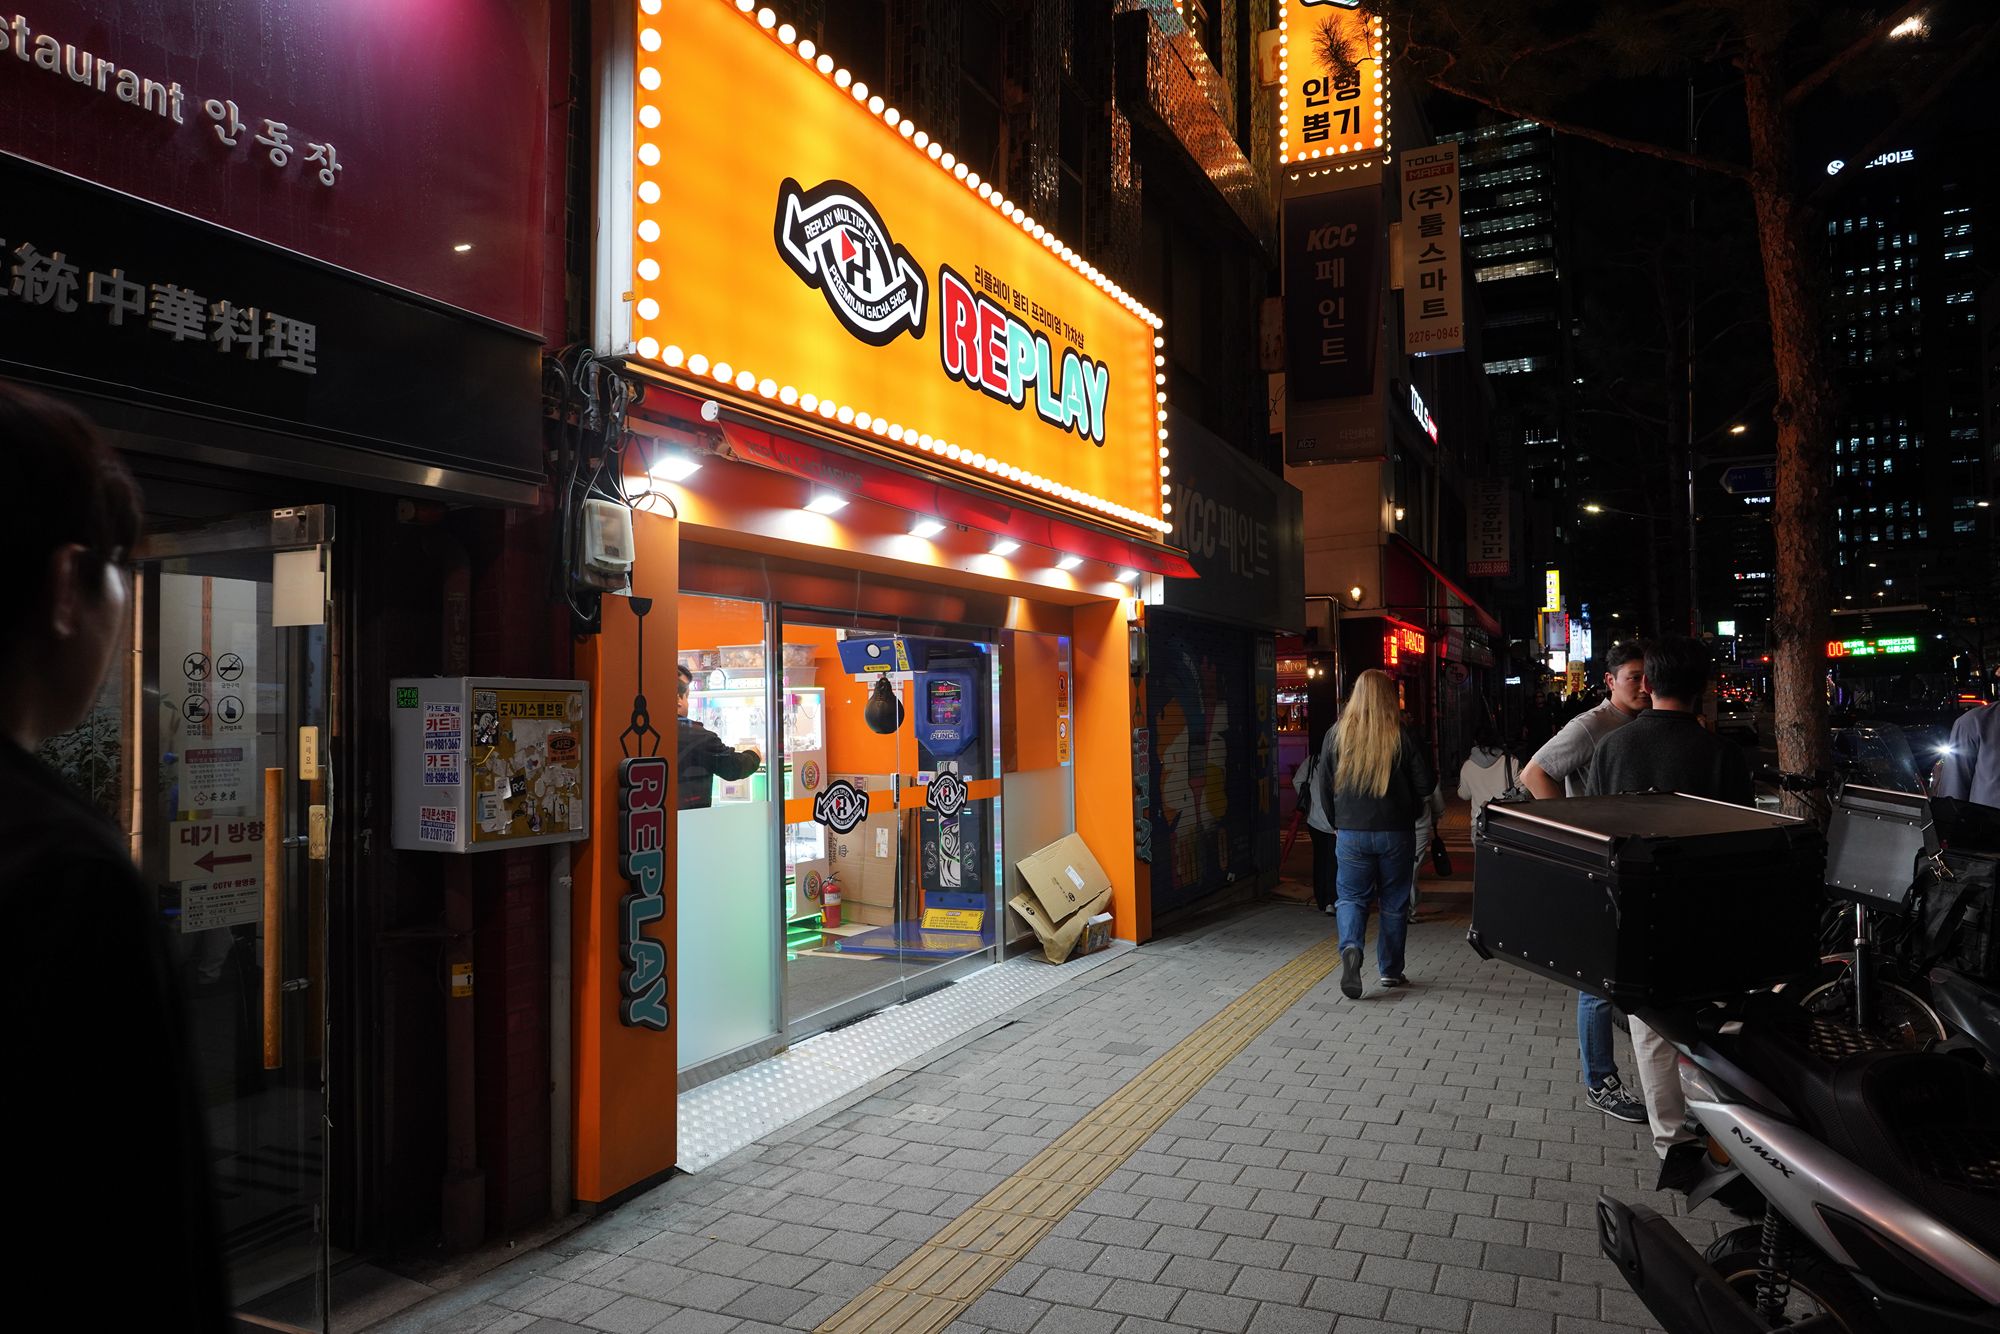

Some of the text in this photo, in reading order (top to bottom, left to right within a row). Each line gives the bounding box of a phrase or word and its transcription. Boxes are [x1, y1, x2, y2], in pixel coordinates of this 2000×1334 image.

[1302, 69, 1361, 108] 인형
[205, 99, 342, 187] 안동장
[1302, 105, 1360, 143] 뽑기
[1405, 151, 1454, 167] TOOLS
[1408, 165, 1449, 179] MART
[804, 207, 879, 250] REPLAY MULTIPLEX
[1307, 223, 1357, 252] KCC
[0, 238, 317, 374] 統中華料理
[828, 264, 908, 319] PREMIUM GACHA SHOP
[974, 264, 1084, 350] 리플레이 멀티 프리미엄 가차샵
[1315, 257, 1348, 365] 페인트
[940, 265, 1109, 446] REPLAY
[1172, 483, 1270, 579] KCC 페인트
[426, 718, 450, 731] 카드
[500, 703, 563, 716] 도시가스밸브함
[427, 755, 450, 767] 카드
[181, 822, 265, 846] 대기 방향
[213, 881, 233, 890] CCTV
[628, 760, 668, 1030] REPLAY
